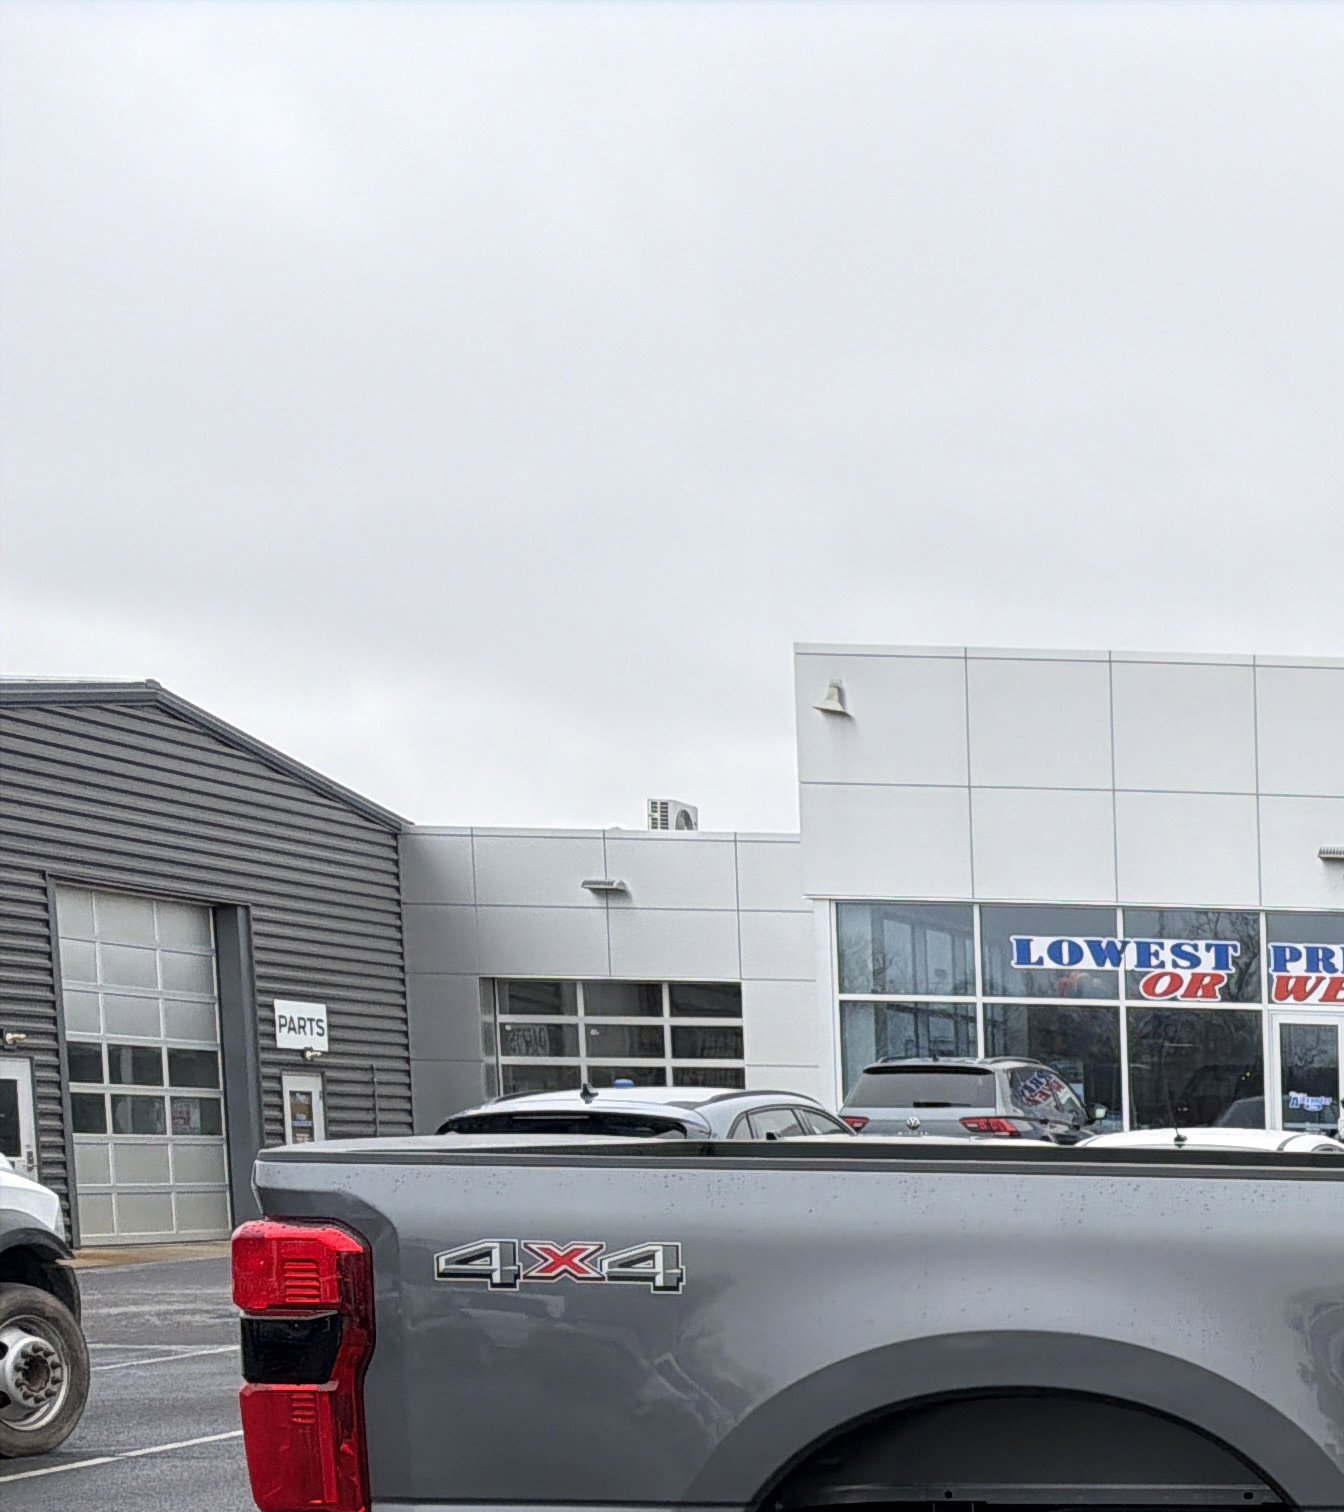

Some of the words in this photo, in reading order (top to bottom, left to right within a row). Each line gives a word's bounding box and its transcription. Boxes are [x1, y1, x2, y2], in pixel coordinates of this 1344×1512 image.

[1011, 937, 1239, 972] LOWEST
[1140, 971, 1226, 999] OR
[277, 1014, 325, 1037] PARTS
